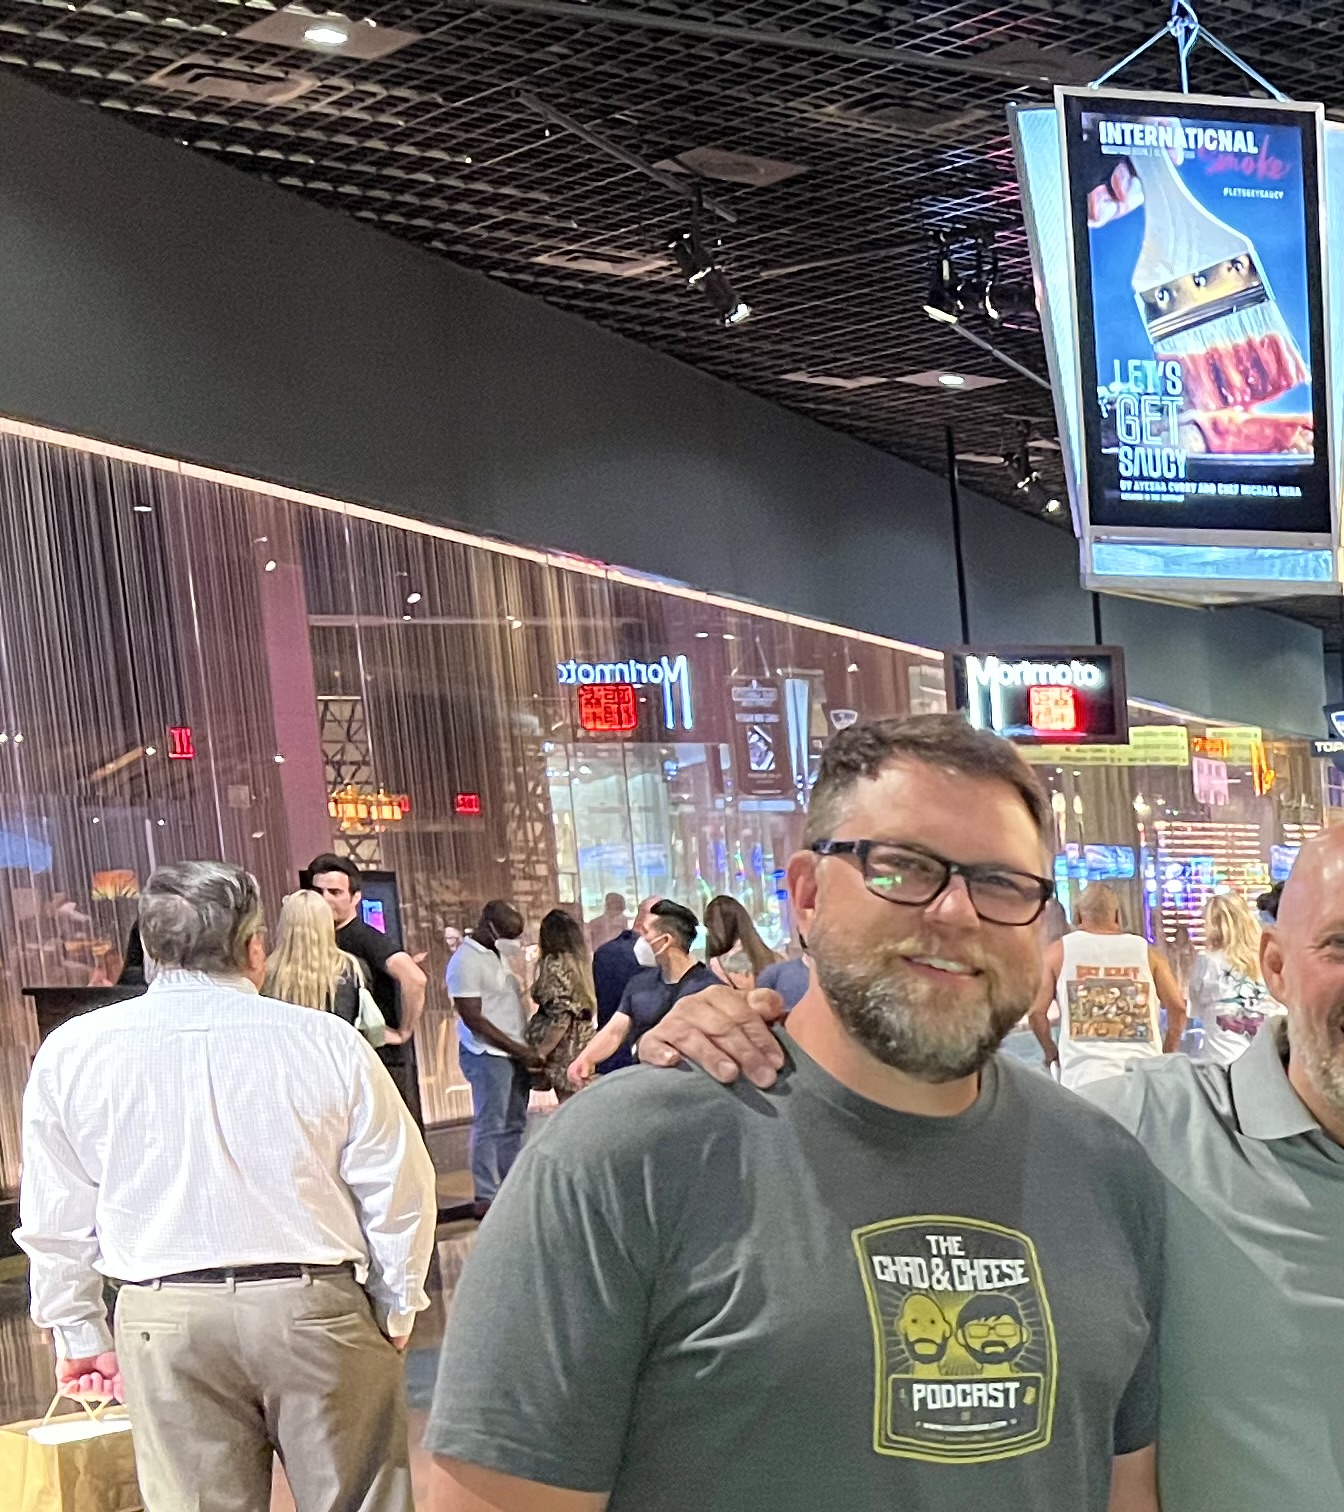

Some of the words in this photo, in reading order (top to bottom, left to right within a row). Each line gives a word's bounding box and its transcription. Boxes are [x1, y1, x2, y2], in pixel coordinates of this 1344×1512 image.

[1099, 121, 1258, 154] INTERNATIONAL
[1114, 359, 1183, 395] LET'S
[1116, 394, 1184, 446] GET
[1118, 446, 1187, 479] SAUCY
[926, 1235, 965, 1256] THE
[872, 1255, 930, 1289] CHAD
[930, 1257, 951, 1291] &
[951, 1258, 1030, 1291] CHEESE
[912, 1382, 1020, 1411] PODCAST
